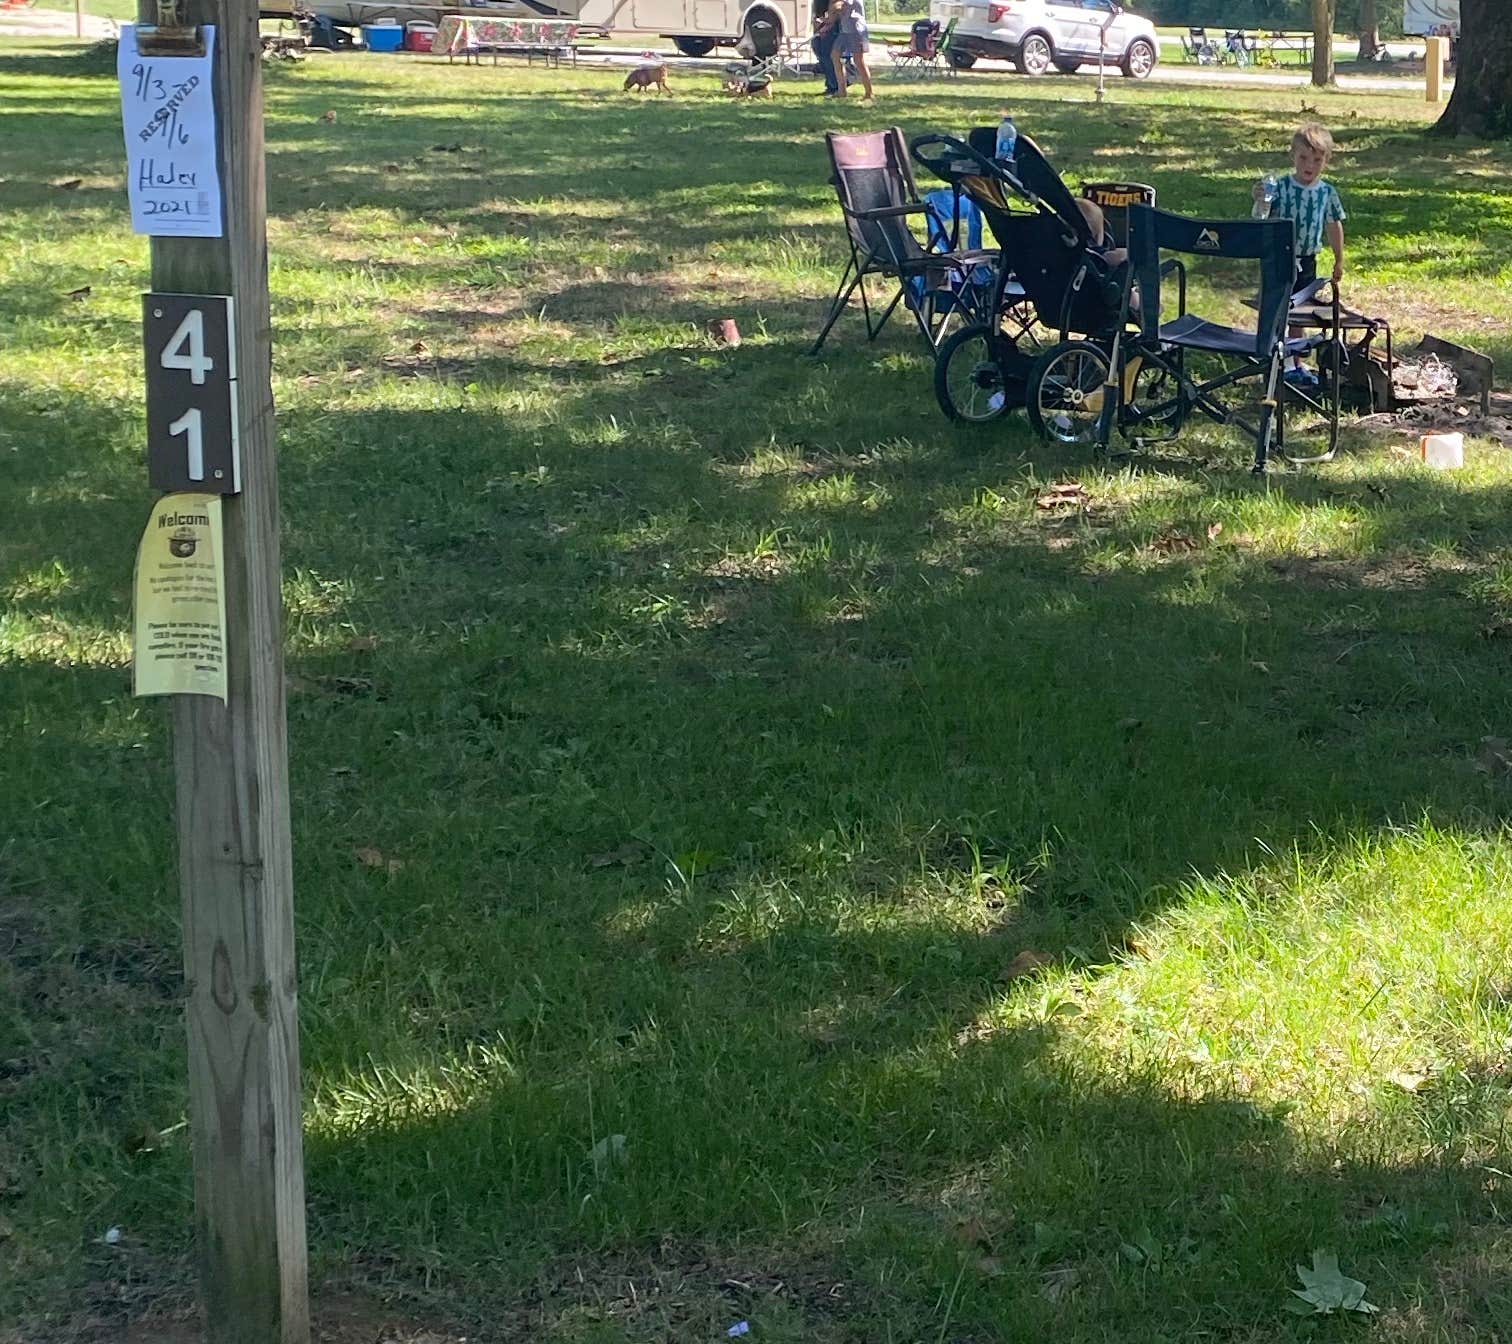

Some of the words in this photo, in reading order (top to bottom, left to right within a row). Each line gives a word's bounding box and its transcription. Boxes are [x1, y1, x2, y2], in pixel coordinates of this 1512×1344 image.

[132, 63, 167, 102] 9/3
[139, 75, 200, 143] RESERVED
[143, 200, 191, 216] 2021
[158, 511, 210, 528] Welcom
